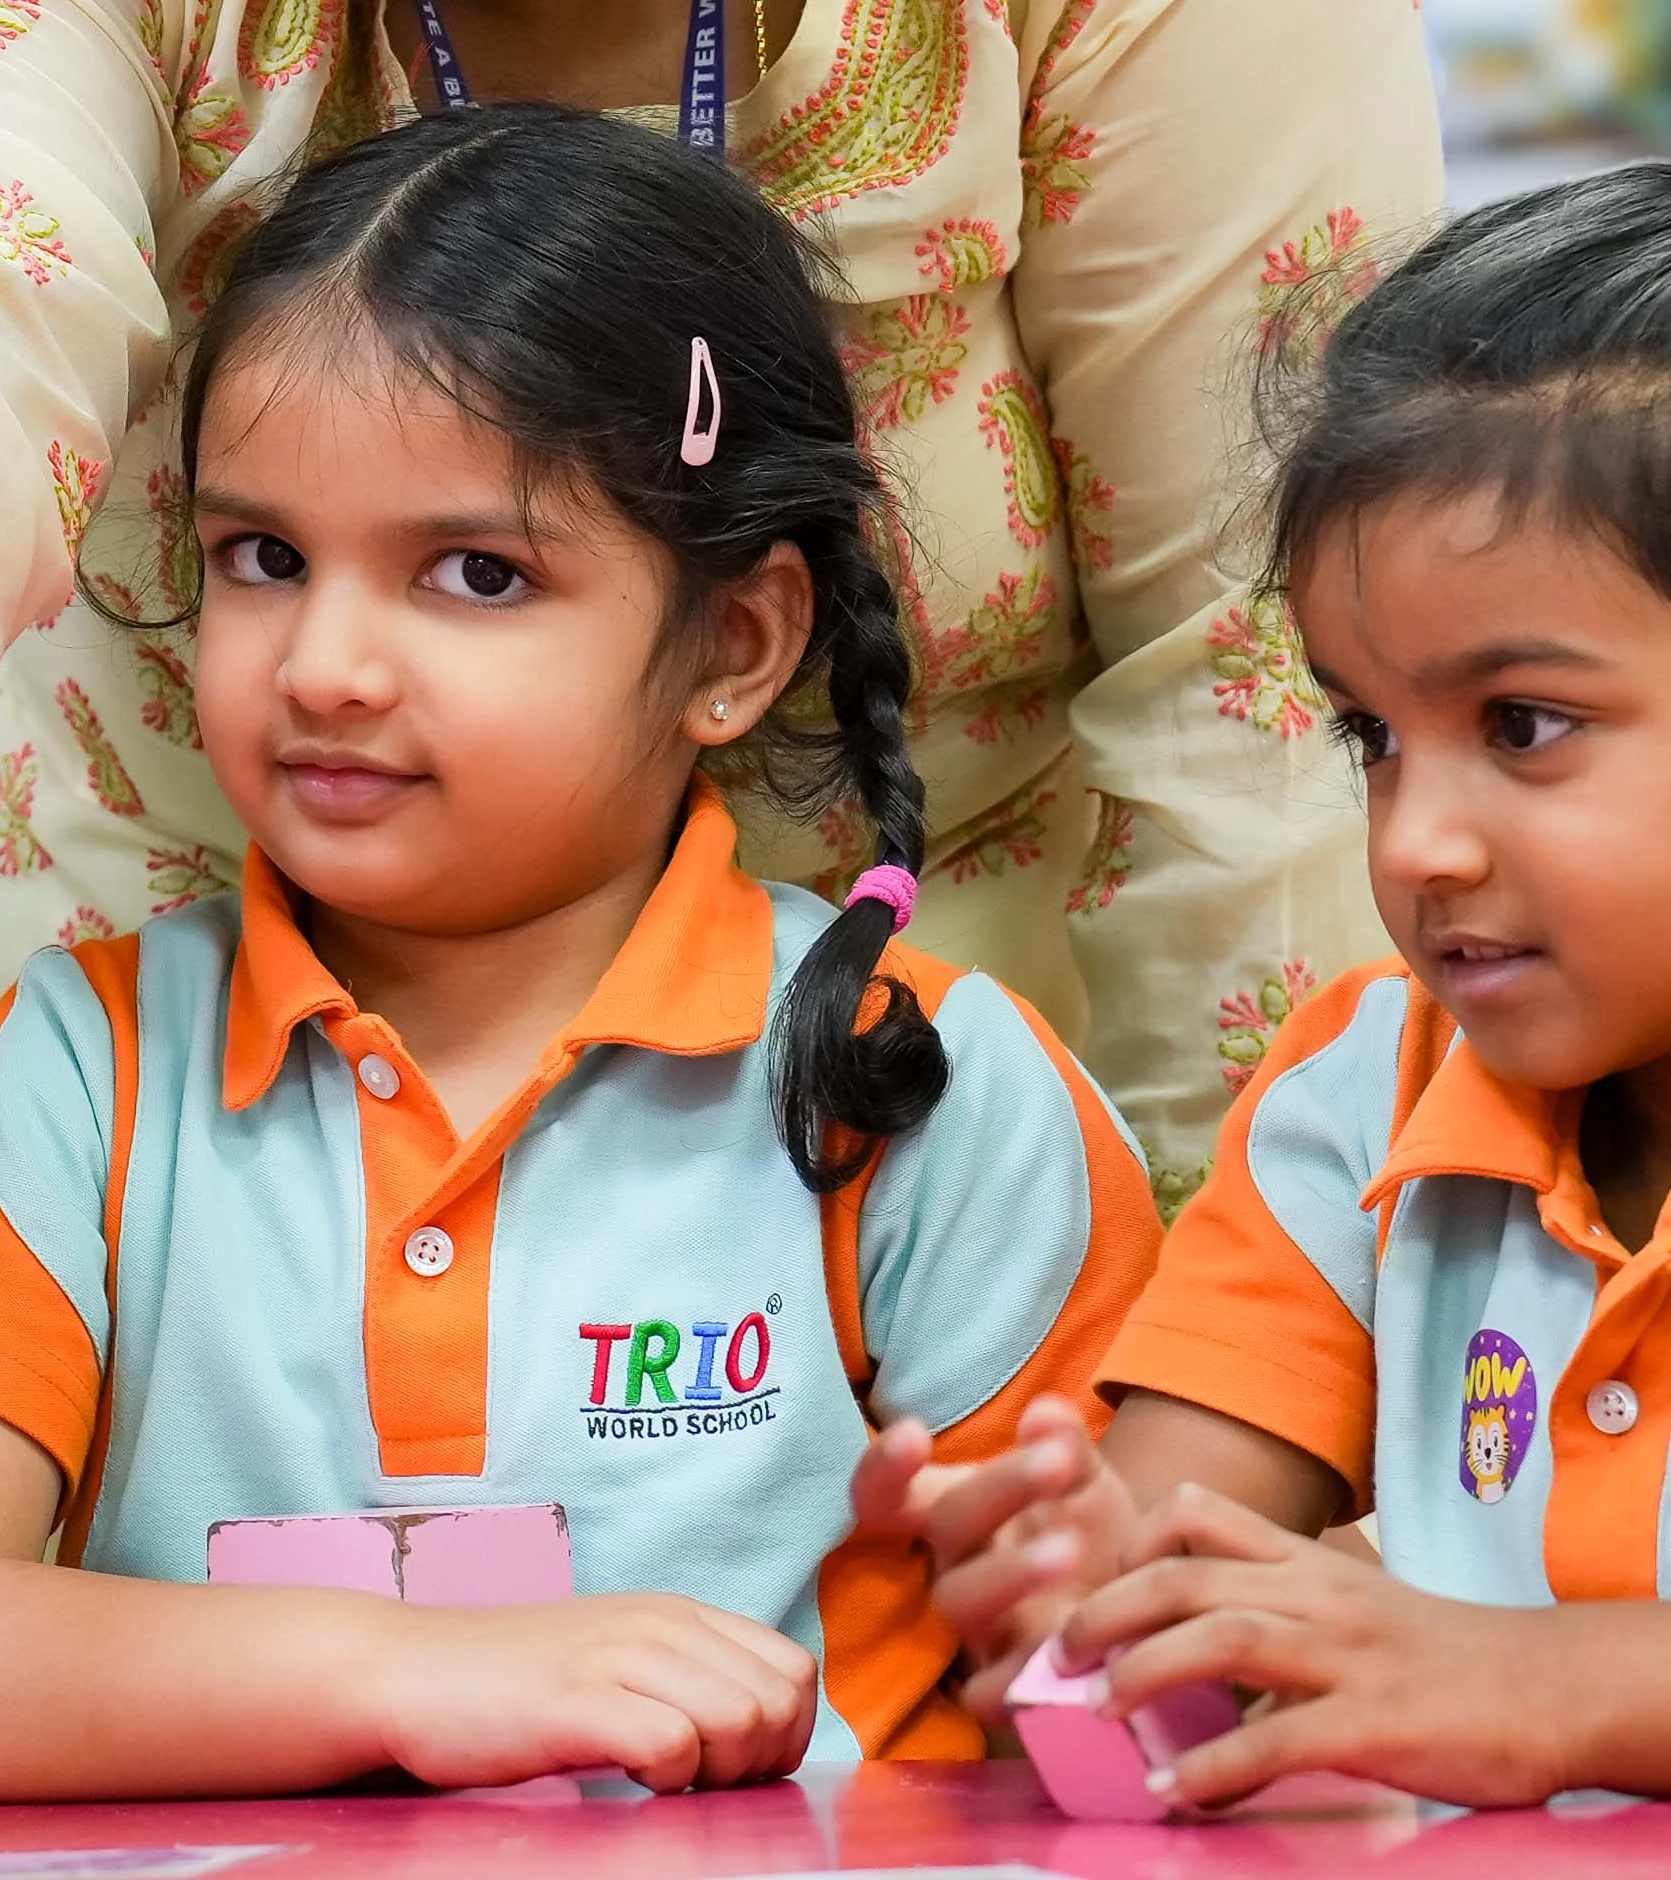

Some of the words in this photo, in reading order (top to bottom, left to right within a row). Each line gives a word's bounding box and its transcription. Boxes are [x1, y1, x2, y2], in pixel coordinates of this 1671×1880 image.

[689, 26, 716, 146] BETTER
[579, 1311, 770, 1406] TRIO
[1463, 1351, 1527, 1404] WOW
[586, 1415, 678, 1439] WORLD
[686, 1400, 777, 1435] SCHOOL
